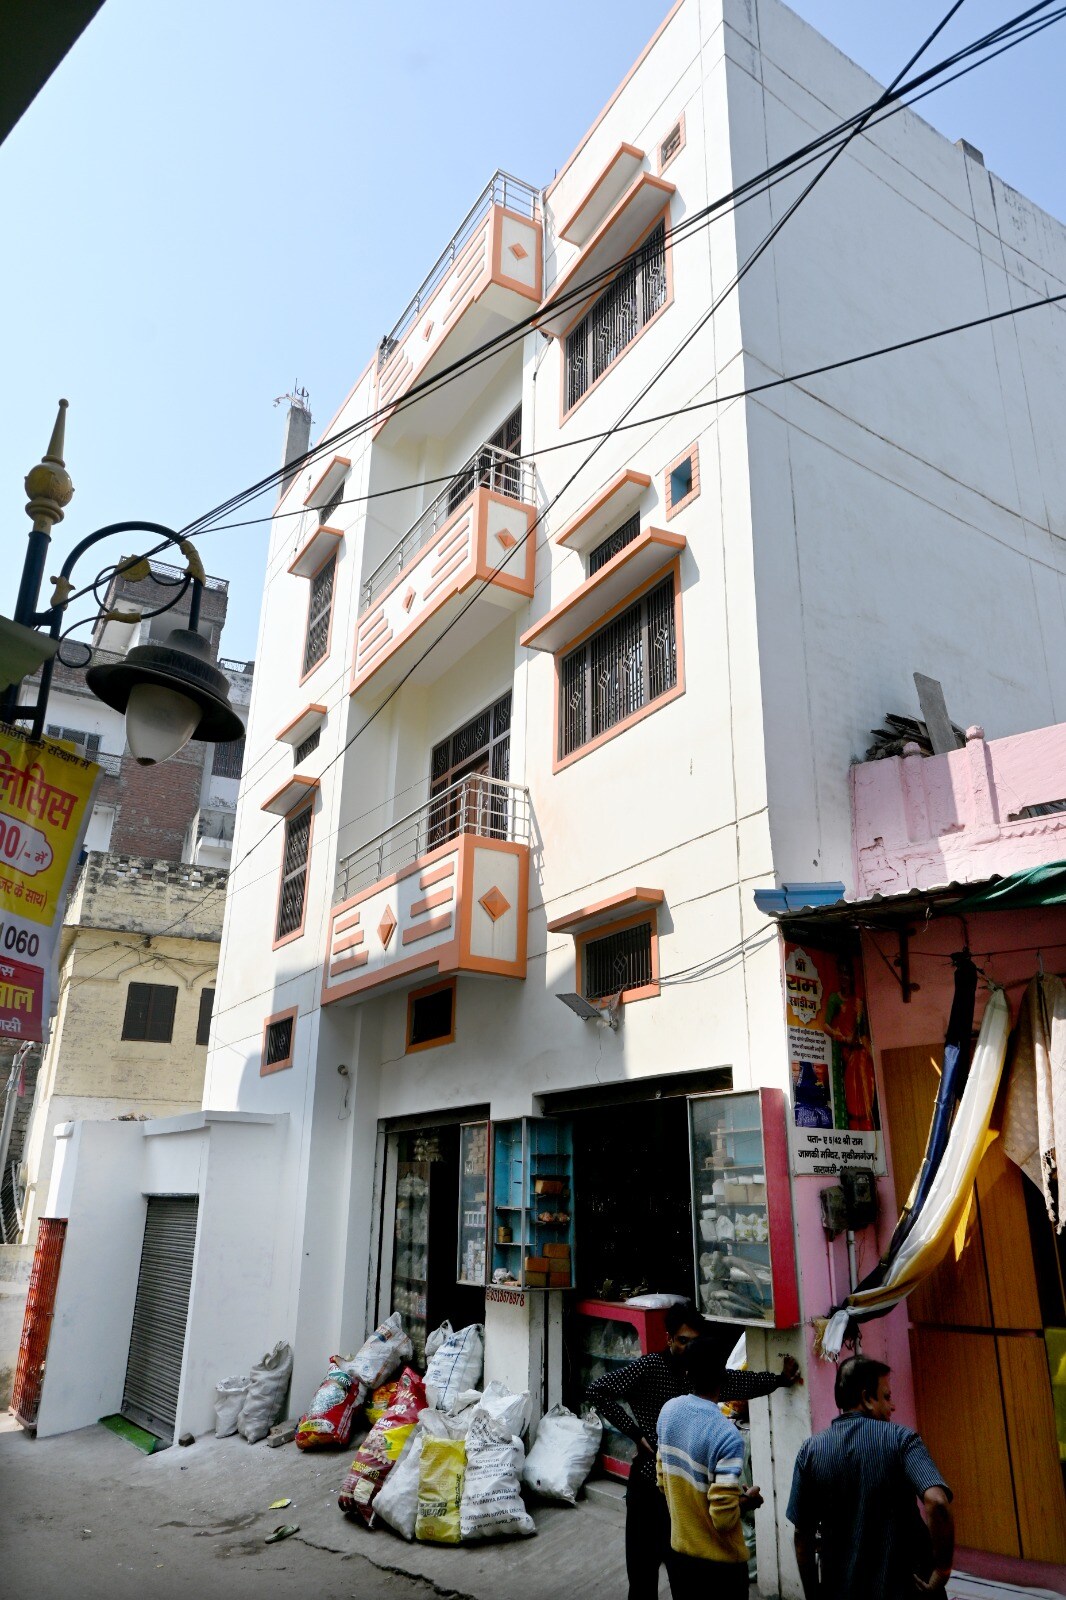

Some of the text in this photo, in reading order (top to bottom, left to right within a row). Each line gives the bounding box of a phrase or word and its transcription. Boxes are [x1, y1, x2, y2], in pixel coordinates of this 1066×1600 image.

[14, 880, 25, 898] के
[786, 974, 818, 995] राम
[842, 1134, 851, 1146] श्री
[851, 1137, 864, 1146] राम
[797, 1147, 820, 1159] जानकी
